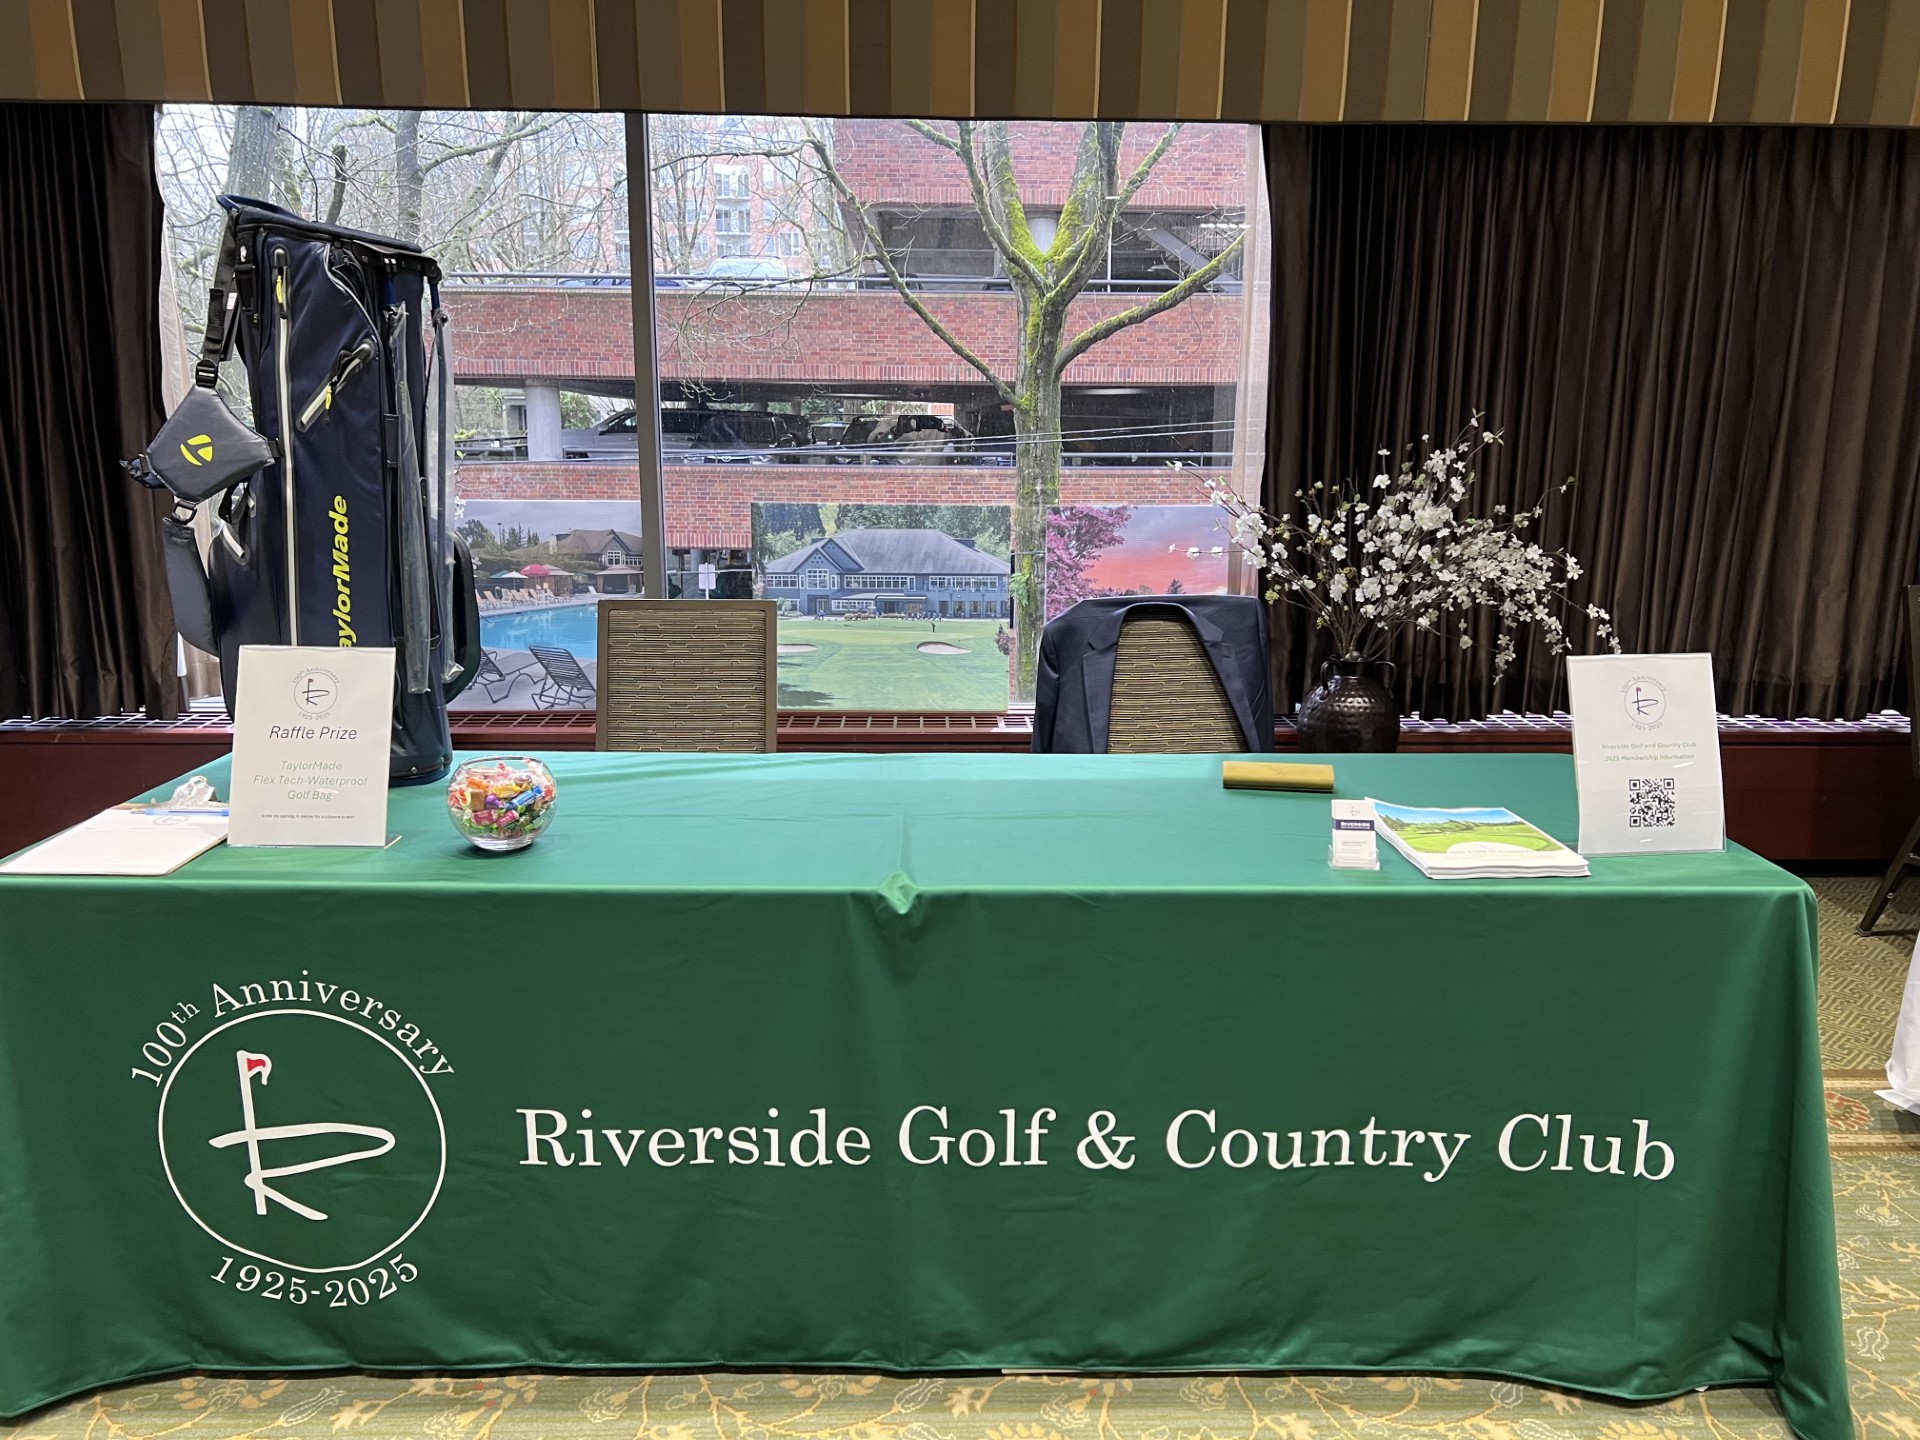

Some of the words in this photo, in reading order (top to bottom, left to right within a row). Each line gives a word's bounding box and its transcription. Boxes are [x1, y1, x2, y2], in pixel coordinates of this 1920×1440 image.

[328, 495, 357, 648] aylorMade
[306, 666, 341, 684] Anniversary
[269, 725, 315, 740] Raffle
[319, 726, 358, 741] Prize
[281, 760, 343, 772] TaylorMade
[253, 774, 276, 785] Flex
[279, 775, 369, 787] Tech-Waterproof
[287, 789, 311, 800] Golf
[312, 790, 333, 802] Bag
[131, 999, 201, 1088] 100th
[211, 969, 456, 1078] Anniversary
[515, 1106, 872, 1168] Riverside
[898, 1104, 1058, 1168] Golf
[1076, 1109, 1137, 1171] &
[1165, 1108, 1473, 1184] Country
[1498, 1112, 1677, 1182] Club
[209, 1252, 419, 1309] 1925-2025
